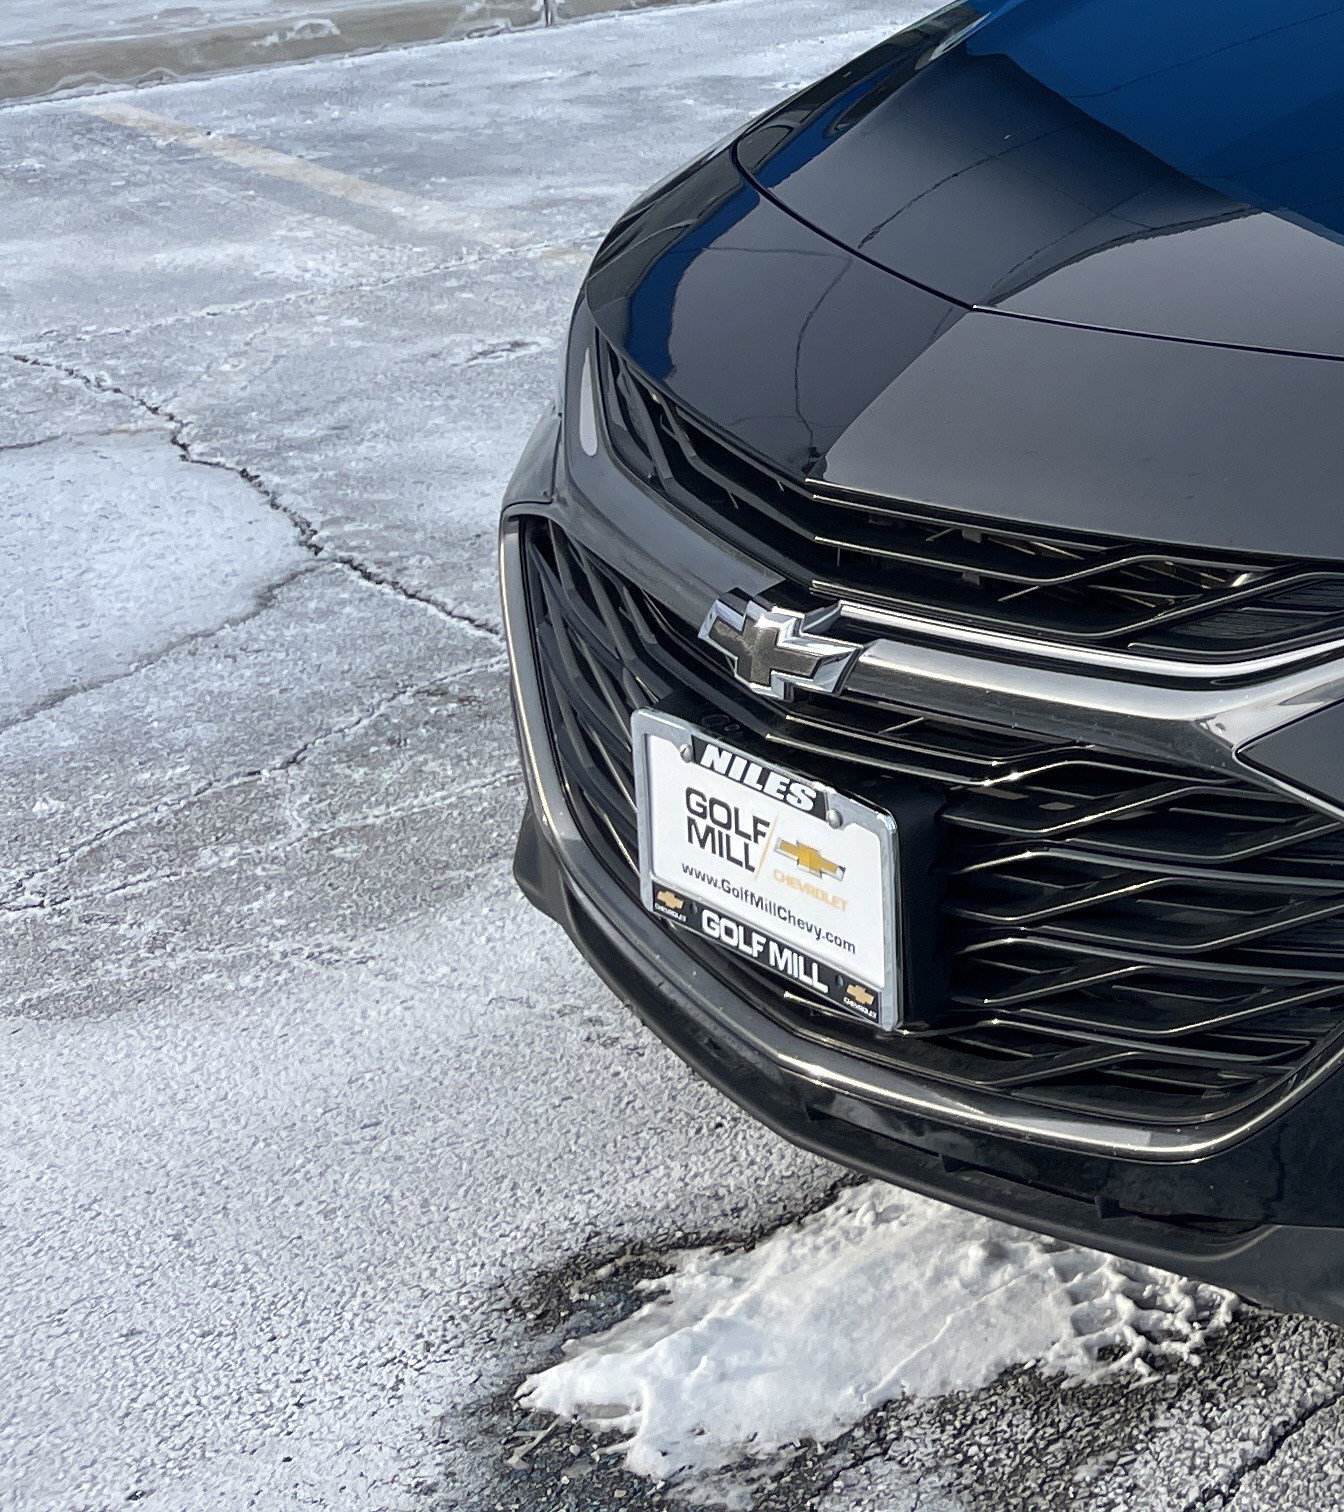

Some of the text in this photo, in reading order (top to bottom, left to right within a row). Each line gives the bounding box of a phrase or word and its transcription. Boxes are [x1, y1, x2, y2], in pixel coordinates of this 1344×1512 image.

[700, 744, 817, 812] NILES
[685, 787, 771, 842] GOLF
[687, 816, 757, 874] MILL
[681, 862, 857, 955] www.GolfMillChevy.com
[772, 868, 848, 913] CHEVROLET
[701, 909, 829, 994] GOLF MILL
